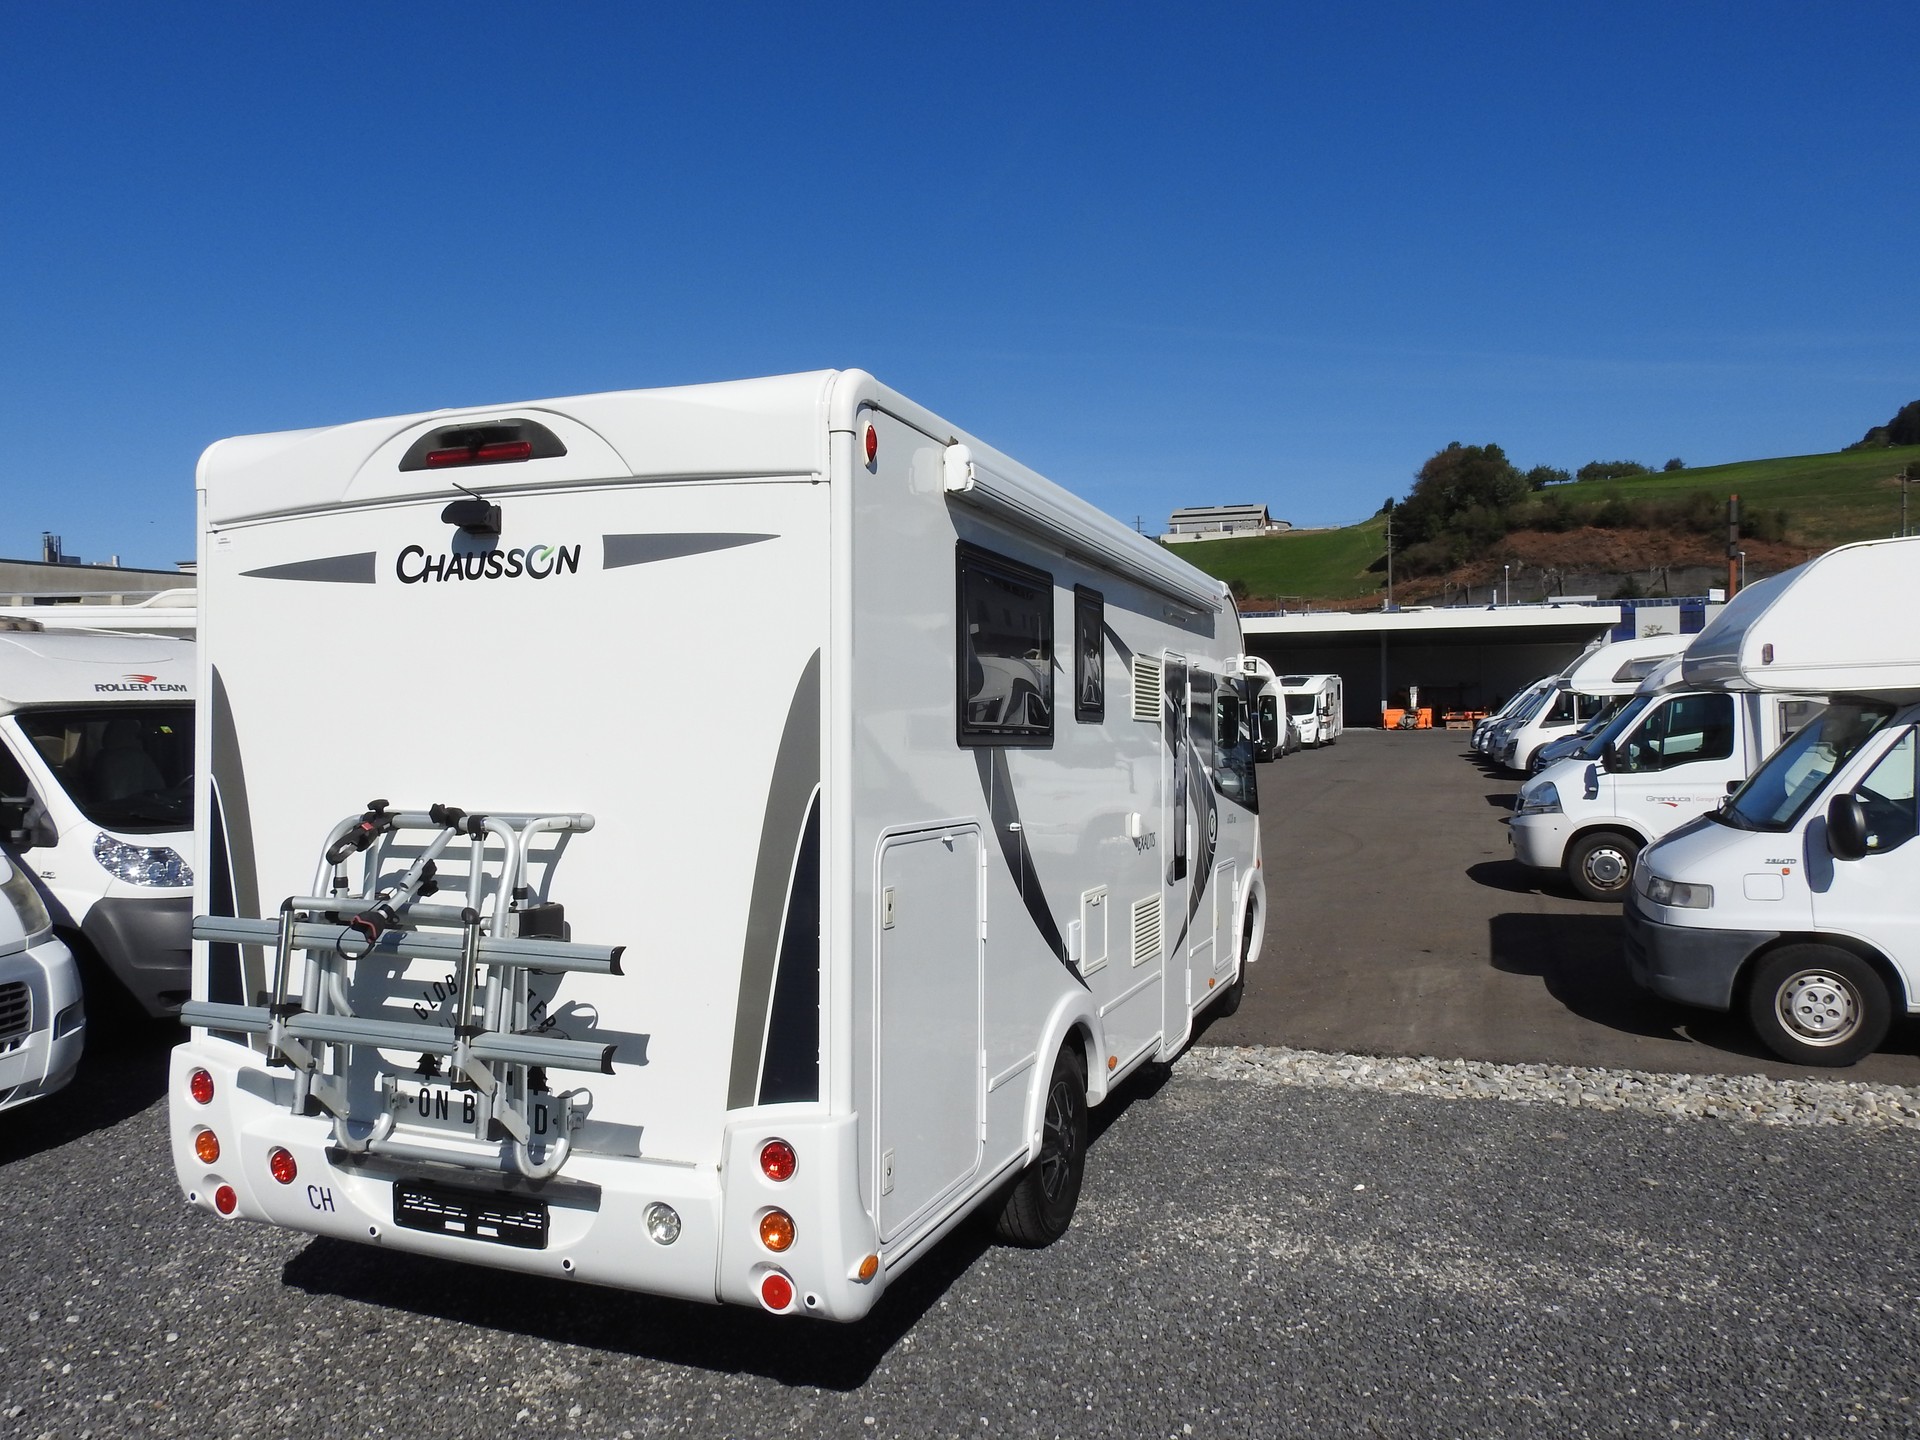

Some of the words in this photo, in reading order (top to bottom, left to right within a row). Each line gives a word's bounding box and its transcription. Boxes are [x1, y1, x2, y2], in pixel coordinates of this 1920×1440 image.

[396, 544, 581, 584] CHAUSSON
[95, 683, 148, 692] ROLLER
[151, 683, 188, 692] TEAM
[418, 1087, 448, 1121] ON
[307, 1184, 335, 1212] CH
